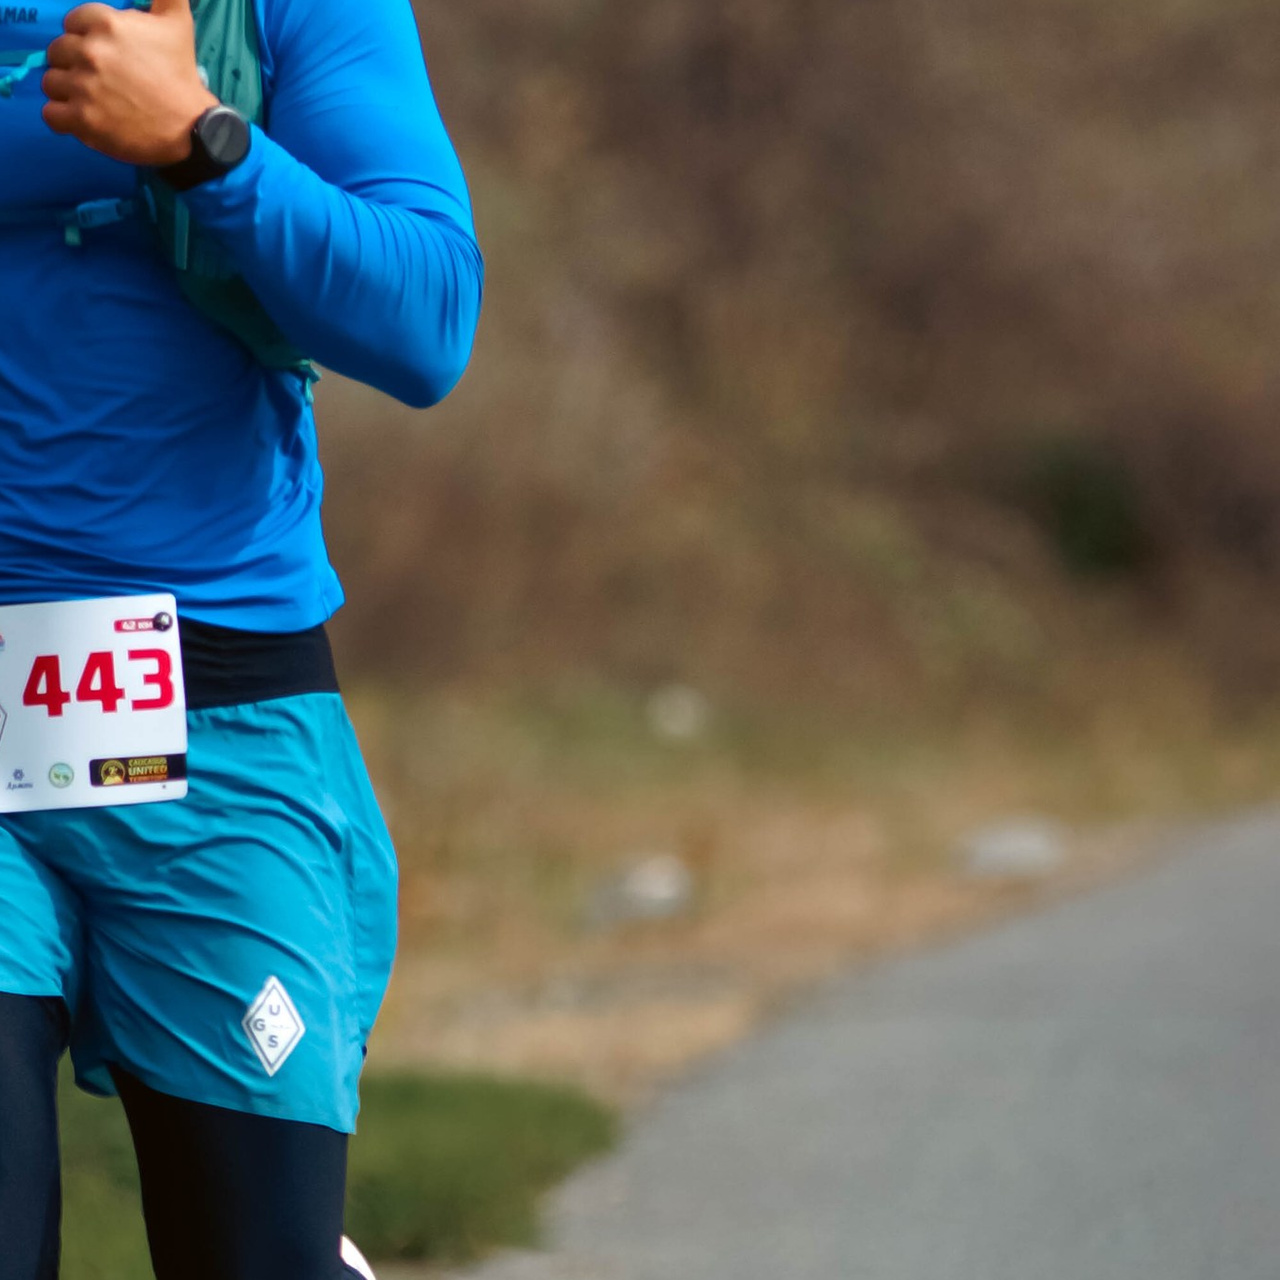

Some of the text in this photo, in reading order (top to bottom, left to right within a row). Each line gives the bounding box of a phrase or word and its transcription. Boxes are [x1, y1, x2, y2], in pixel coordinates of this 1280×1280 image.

[23, 648, 175, 717] 443
[128, 765, 168, 776] UNITED
[268, 1004, 280, 1016] U
[253, 1018, 266, 1032] G
[267, 1034, 279, 1048] S
